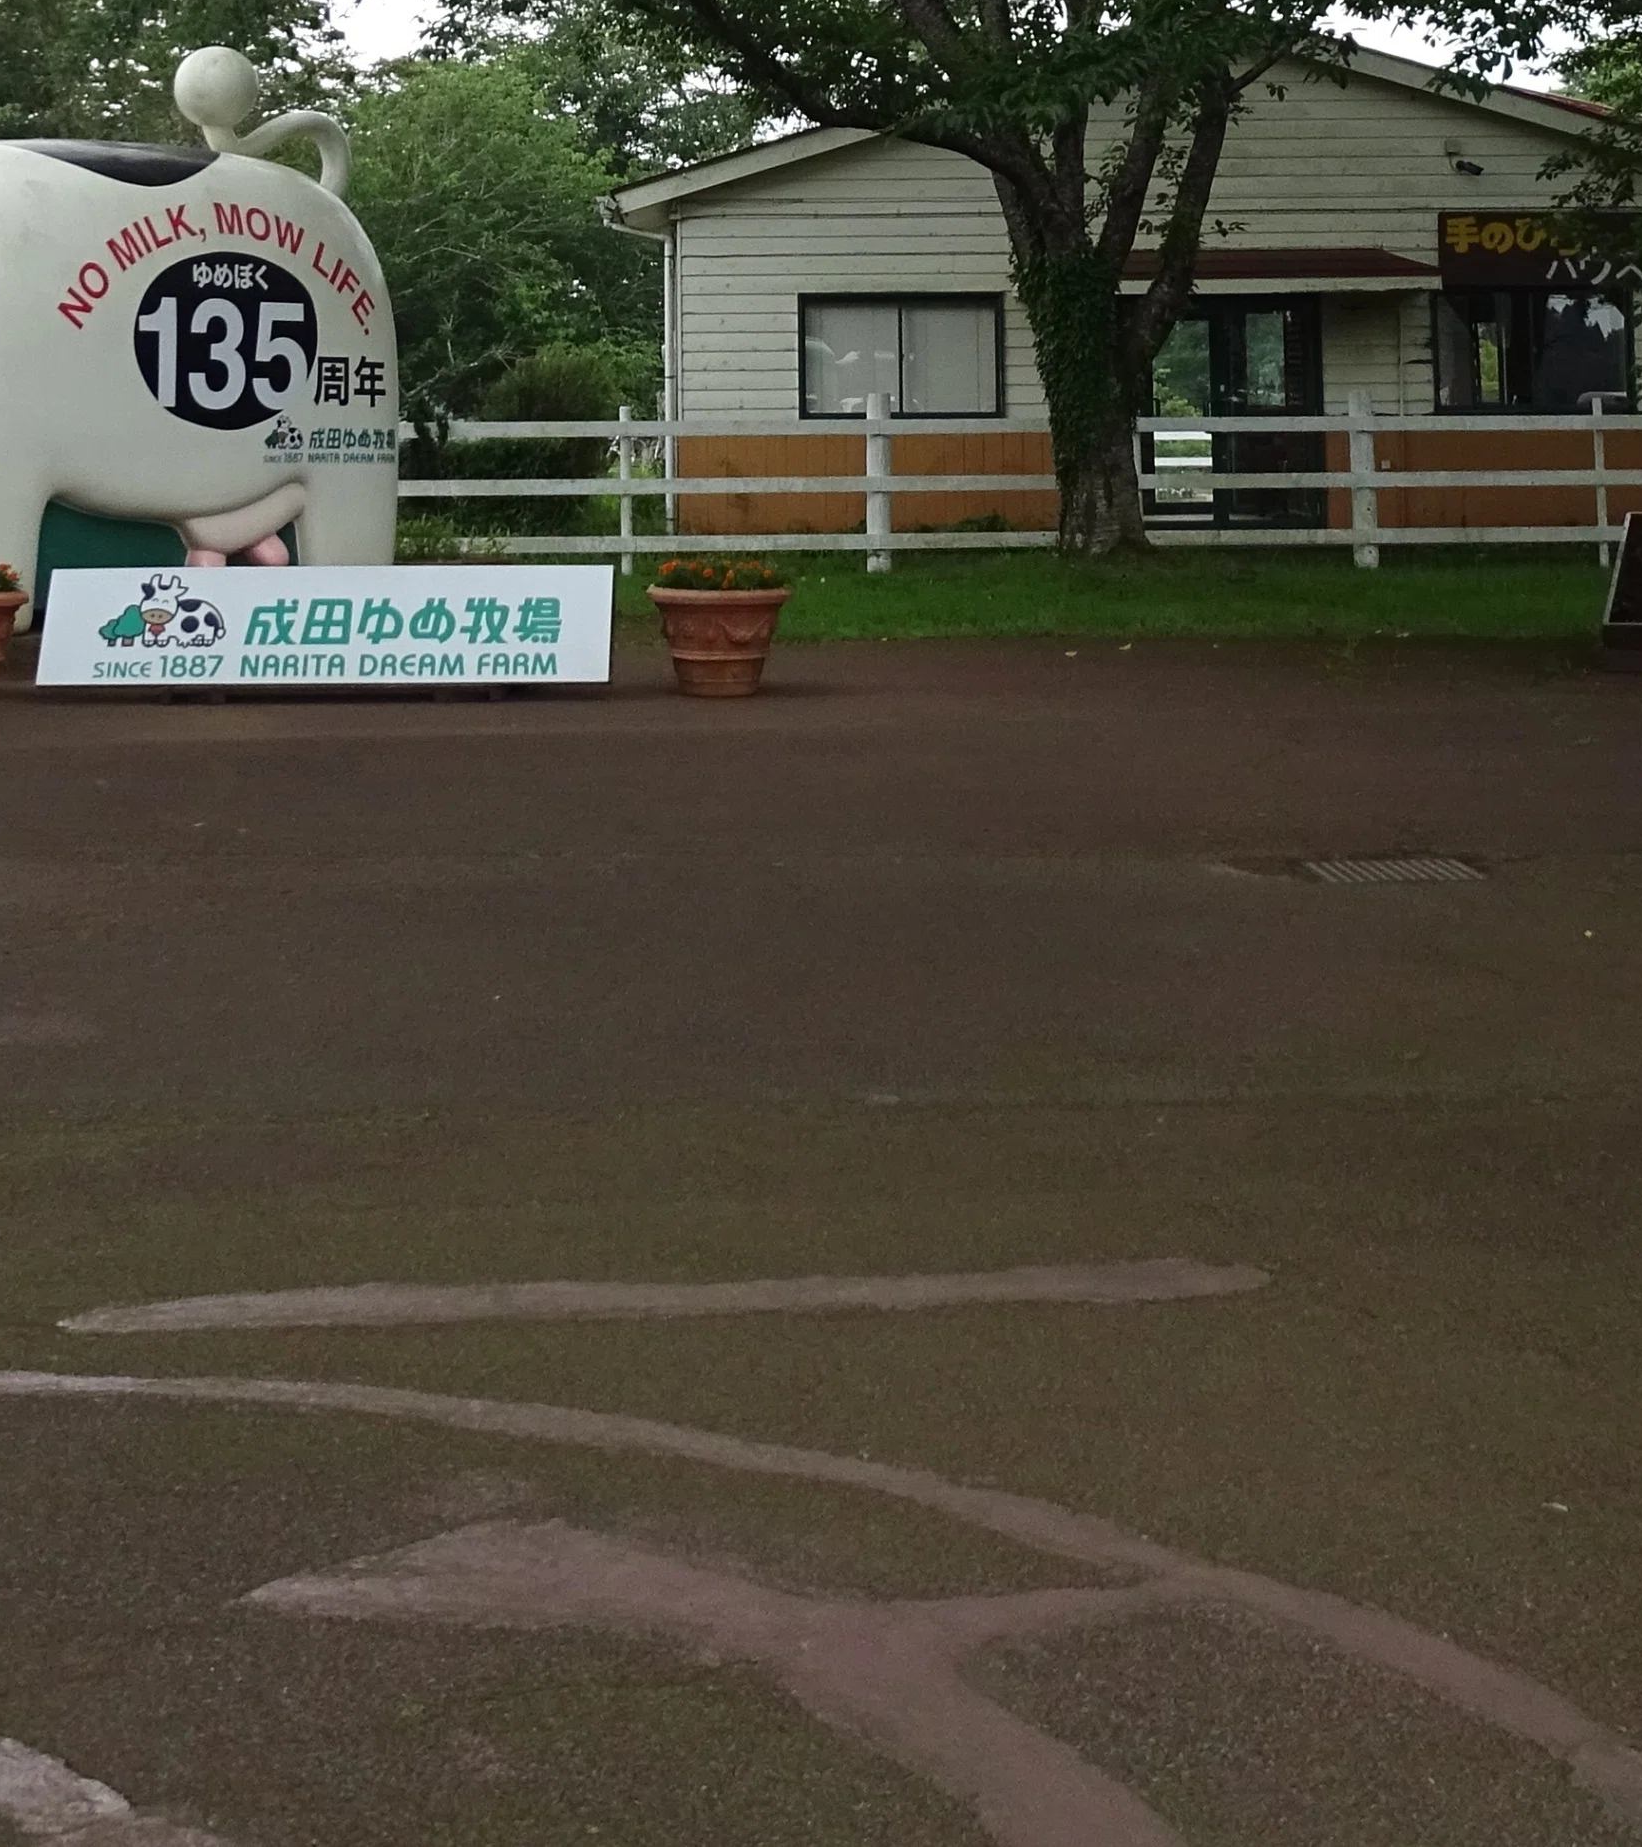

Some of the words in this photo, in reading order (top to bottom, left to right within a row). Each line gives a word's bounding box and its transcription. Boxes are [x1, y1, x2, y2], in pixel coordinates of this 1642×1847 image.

[57, 262, 109, 329] NO
[106, 204, 207, 271] MILK,
[213, 202, 305, 254] MOW
[312, 241, 376, 335] LIFE.
[192, 263, 269, 290] ゆめぼく
[138, 296, 308, 411] 135
[314, 356, 386, 407] 周年
[244, 596, 562, 645] 成田ゆめ牧場
[92, 661, 152, 679] SINCE
[159, 655, 224, 679] 1887
[240, 654, 346, 678] NARITA
[359, 653, 465, 678] DREAM
[476, 653, 559, 677] FARM
